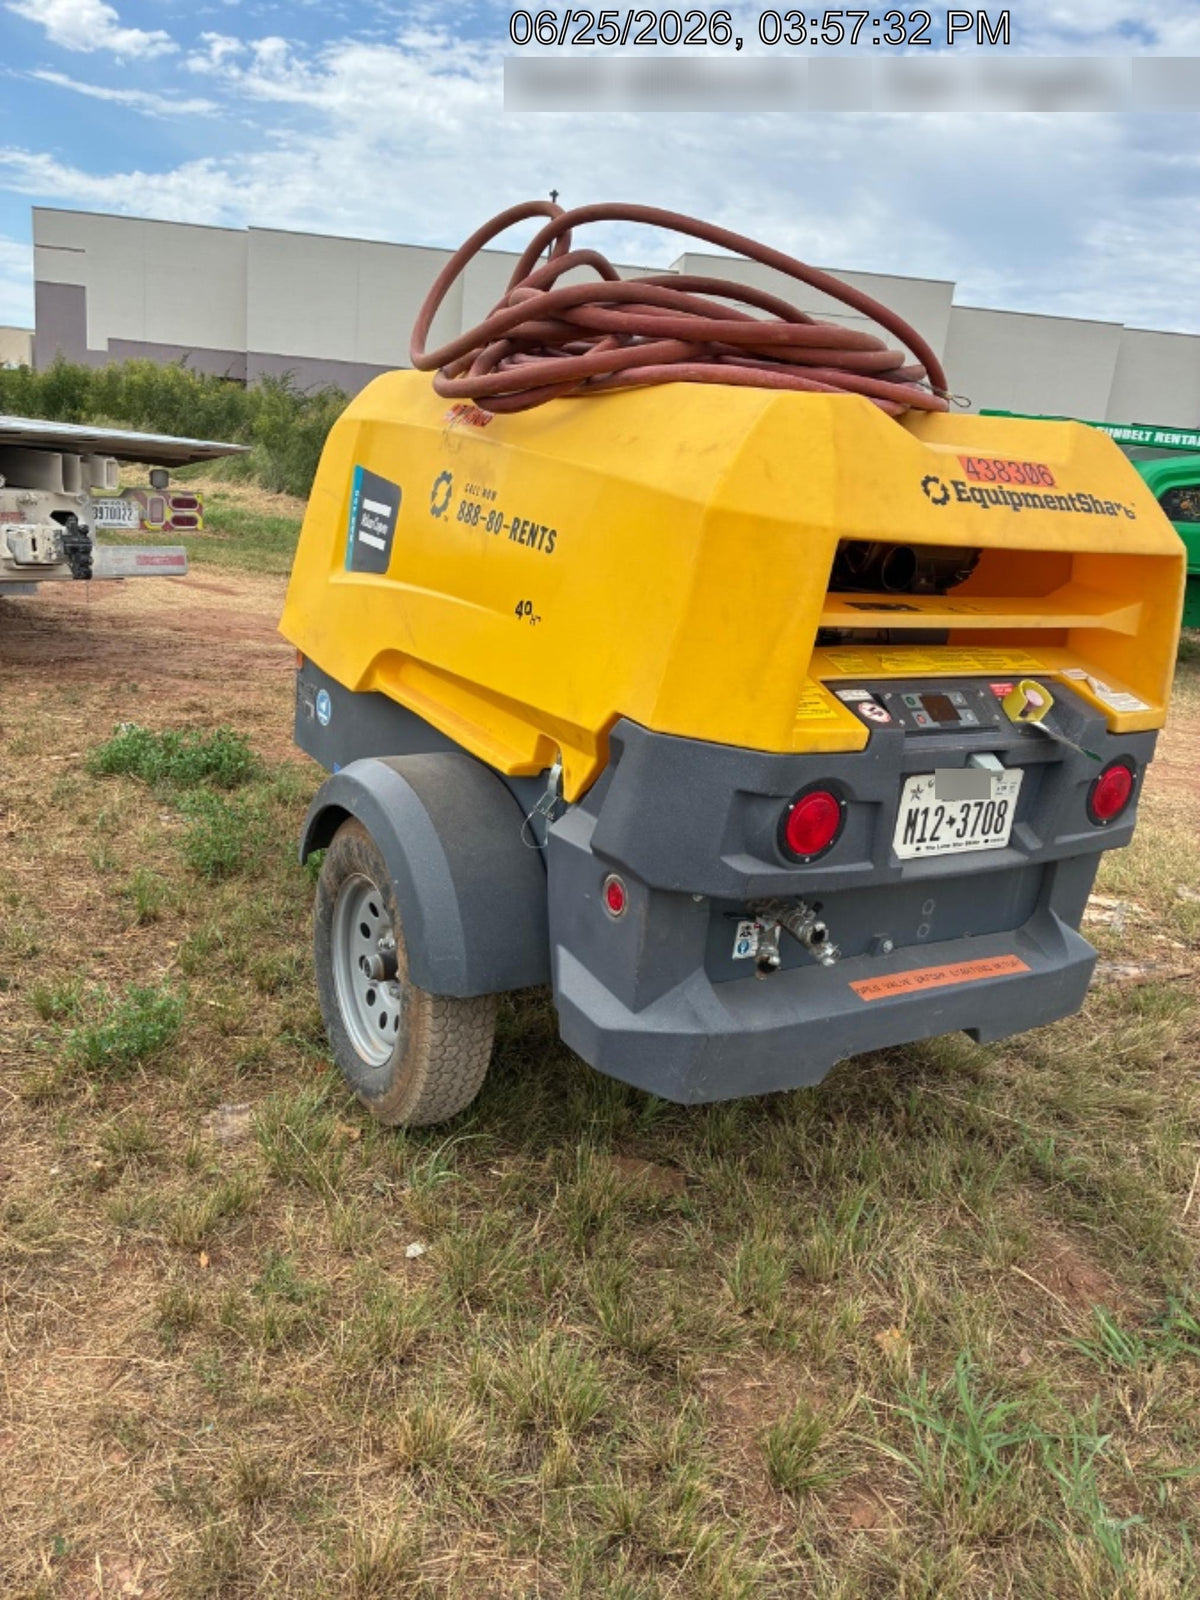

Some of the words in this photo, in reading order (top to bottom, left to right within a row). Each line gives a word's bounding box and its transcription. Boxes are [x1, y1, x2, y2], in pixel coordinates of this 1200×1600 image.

[964, 457, 1054, 487] 438306
[456, 499, 557, 554] 888-80-RENTS
[956, 799, 1009, 839] 3708
